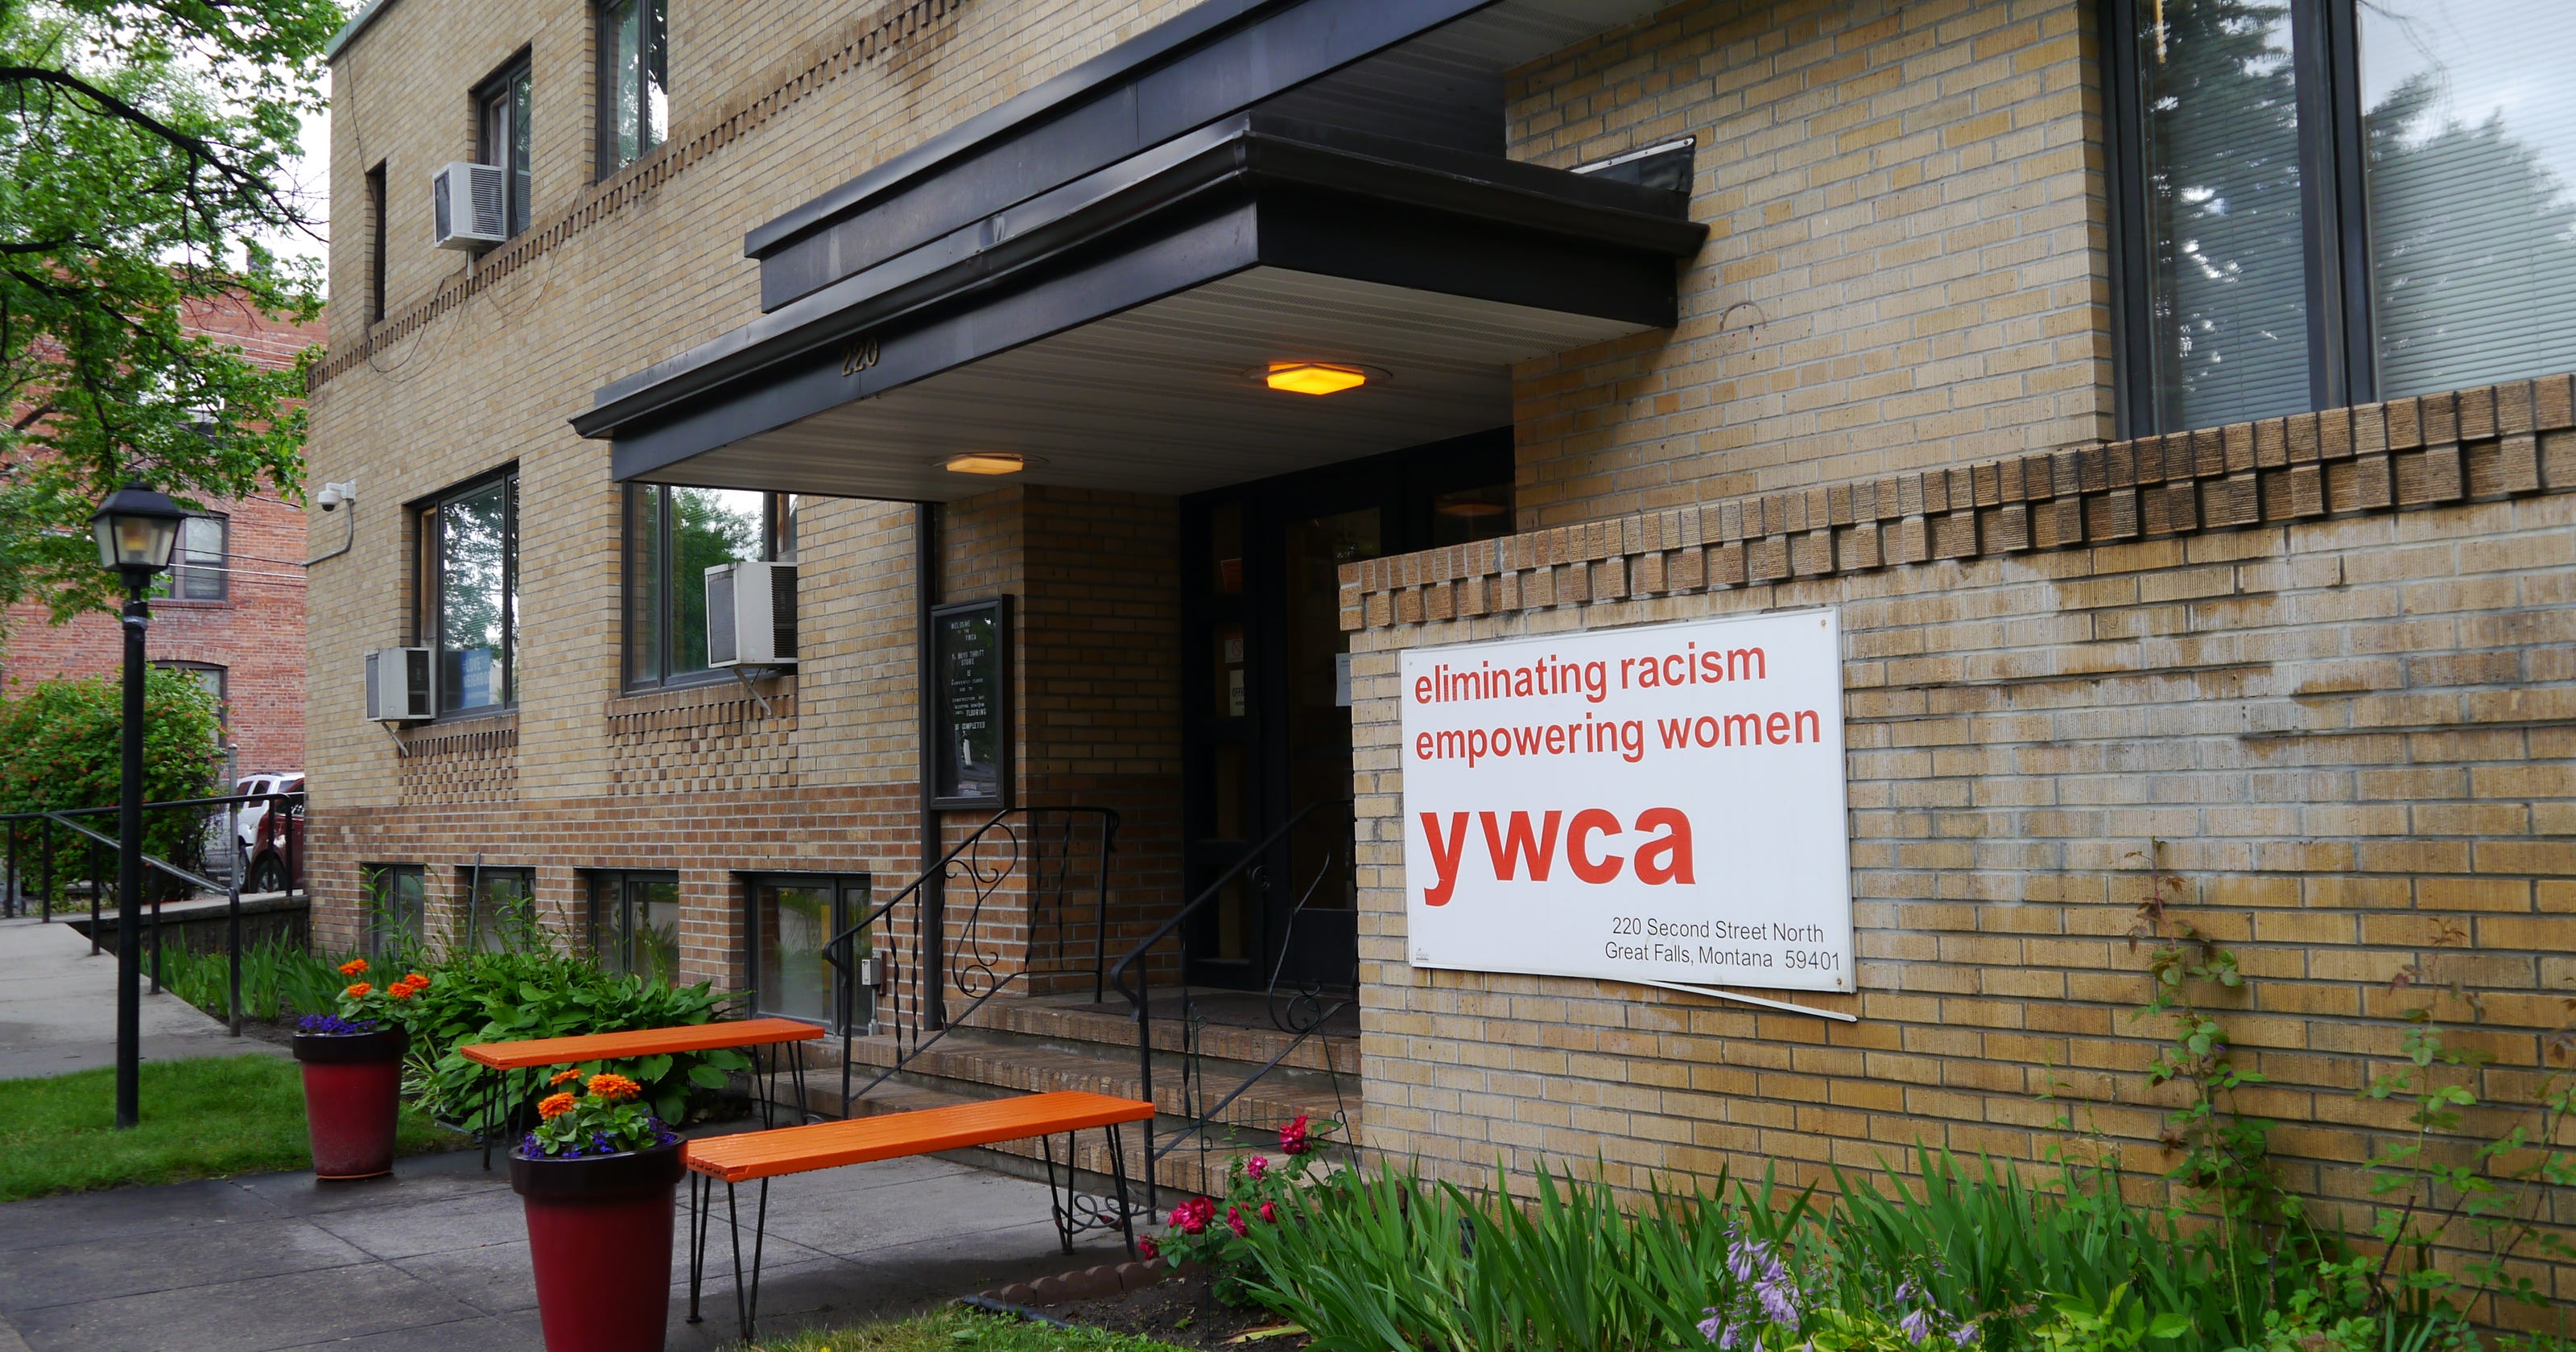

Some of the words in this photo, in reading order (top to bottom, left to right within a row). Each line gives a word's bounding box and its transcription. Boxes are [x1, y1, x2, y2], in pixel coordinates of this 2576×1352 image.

[841, 339, 880, 377] 220
[961, 657, 974, 666] STORE
[1414, 653, 1608, 705] eliminating
[1620, 641, 1765, 690] racism
[962, 721, 985, 730] COMPLETED
[966, 708, 986, 716] FLOORING
[1415, 711, 1645, 769] empowering
[1657, 710, 1821, 750] women
[1419, 806, 1695, 907] ywca
[1612, 917, 1641, 935] 220
[1647, 917, 1709, 939] Second
[1715, 920, 1767, 941] Street
[1773, 922, 1823, 942] North
[1605, 941, 1649, 961] Great
[1654, 943, 1695, 967] Falls,
[1699, 946, 1773, 967] Montana
[1785, 950, 1839, 971] 59401
